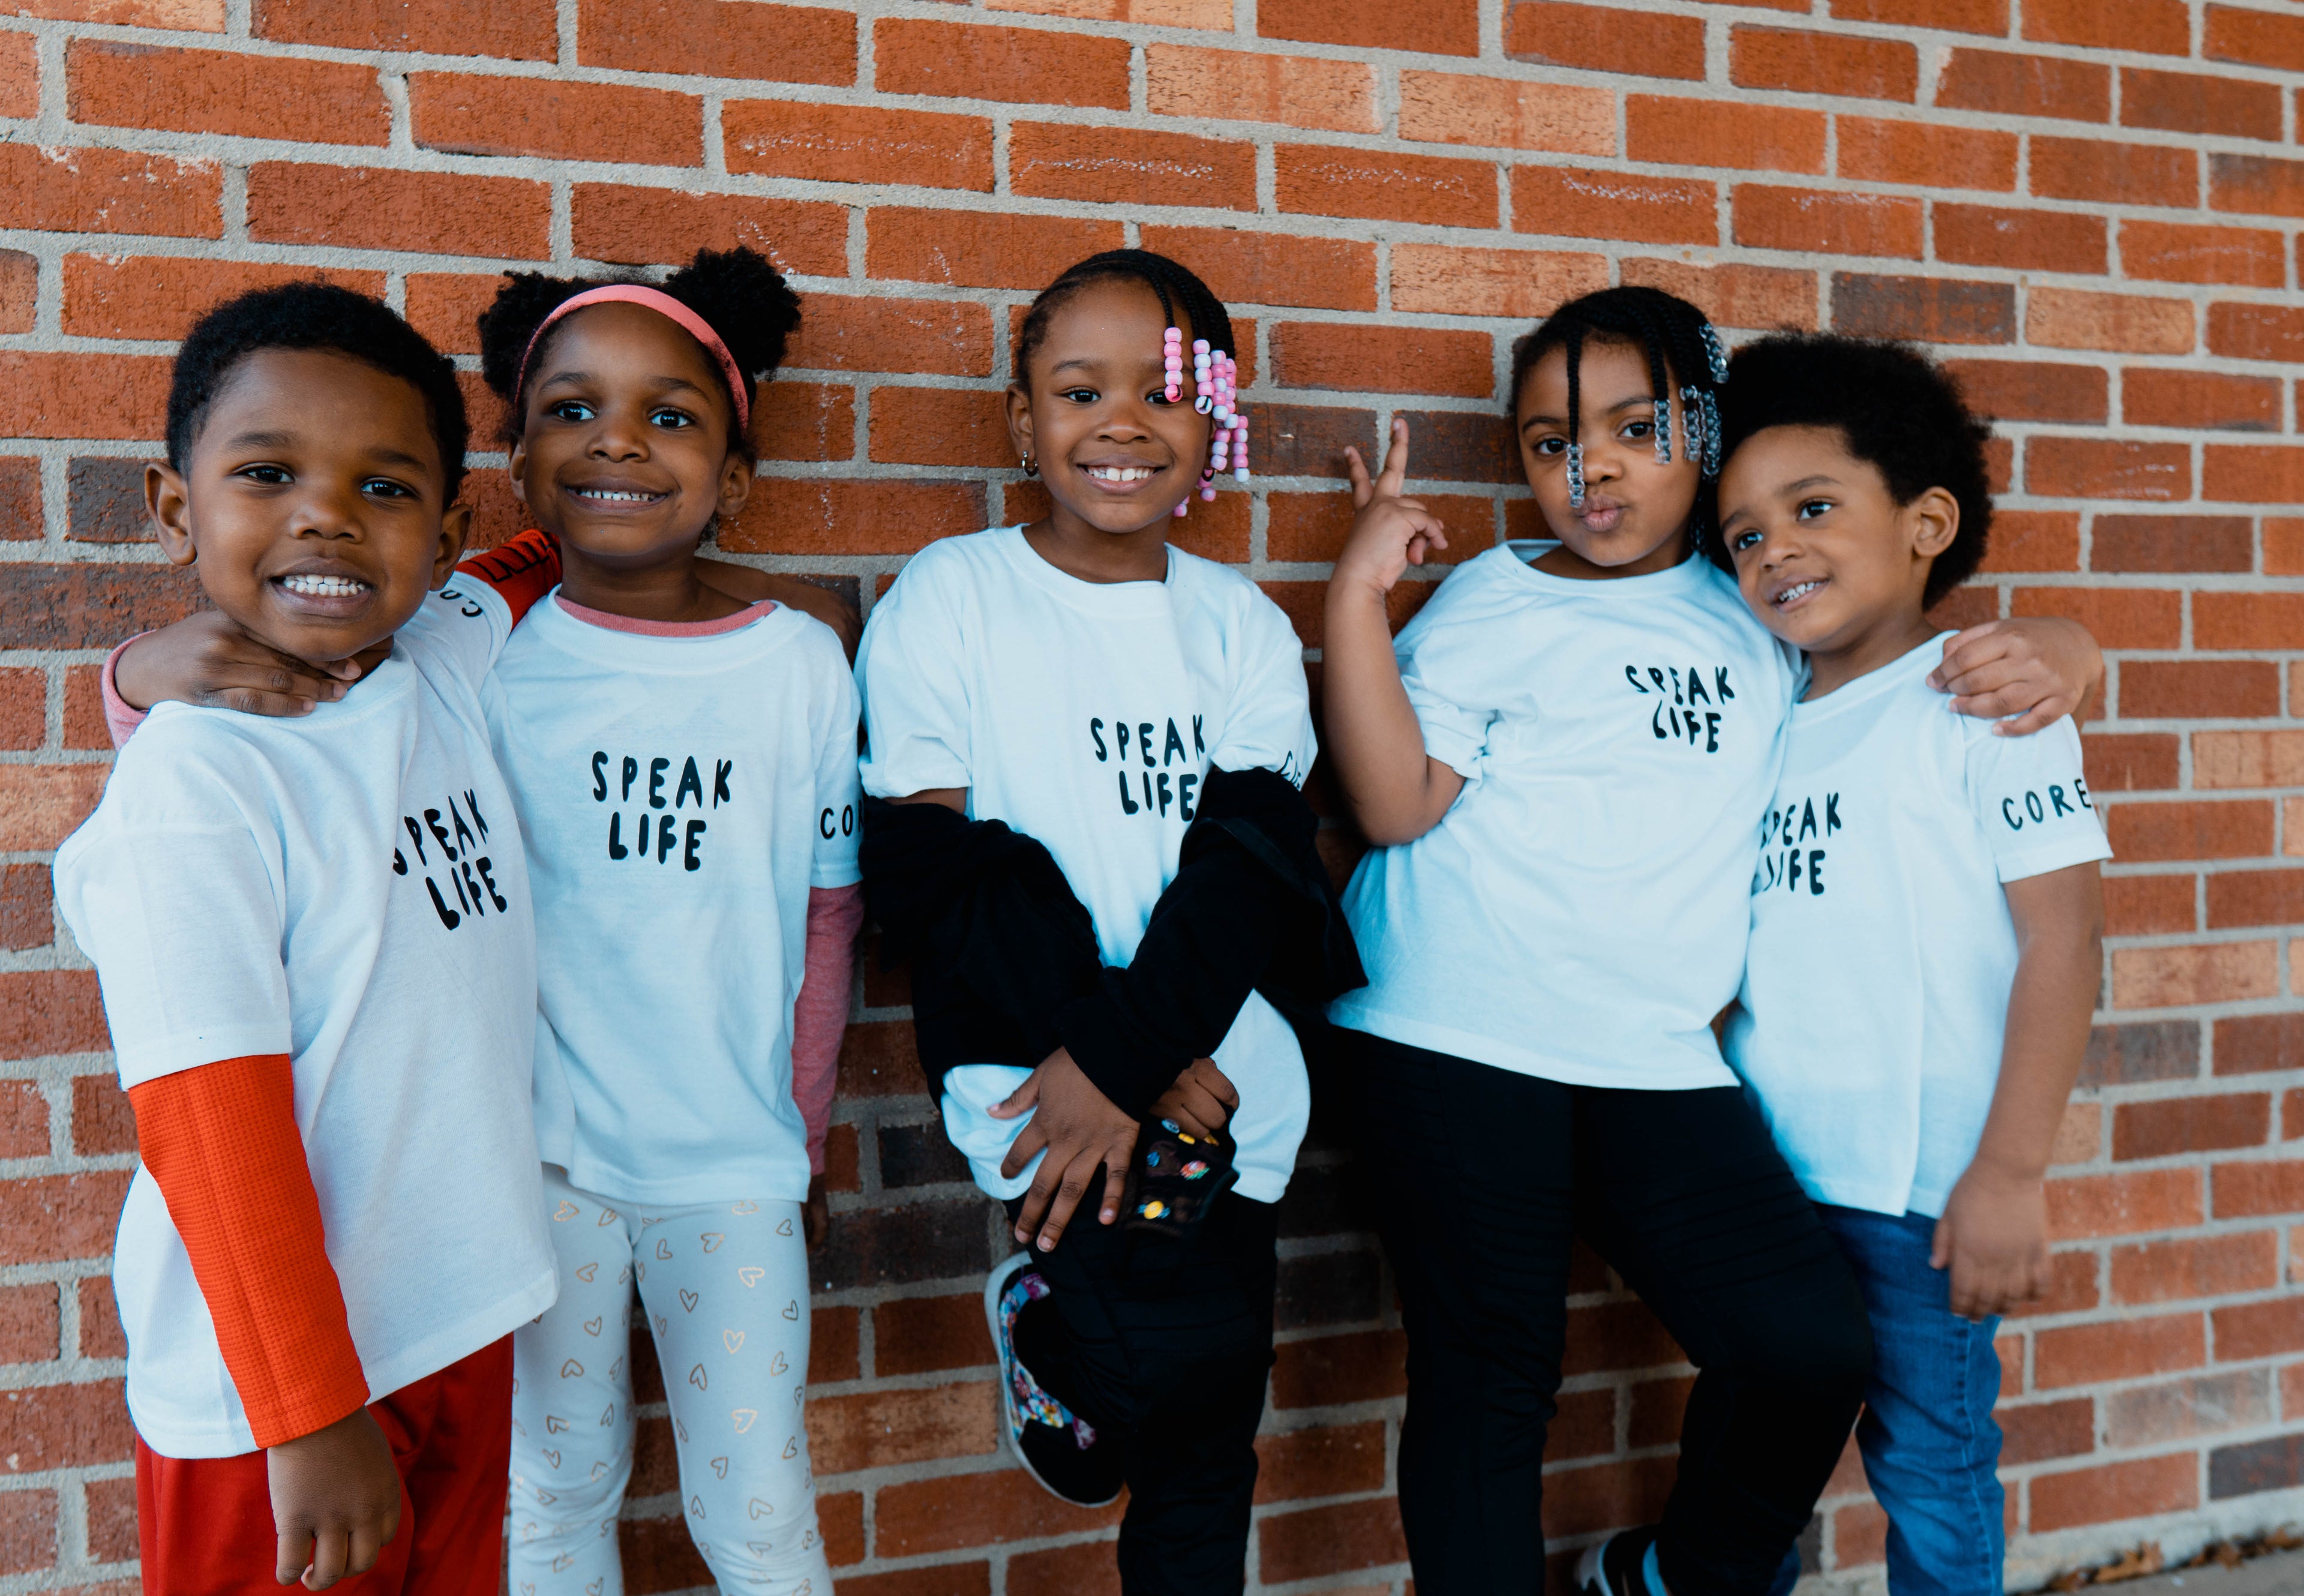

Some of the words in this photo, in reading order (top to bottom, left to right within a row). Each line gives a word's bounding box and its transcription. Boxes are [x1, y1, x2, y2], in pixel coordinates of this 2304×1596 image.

[1625, 665, 1735, 706] SPEAK
[1090, 714, 1205, 768] SPEAK
[1652, 700, 1721, 752] LIFE
[591, 751, 733, 810] SPEAK
[1119, 770, 1198, 822] LIFE
[2002, 778, 2092, 830] CORE
[608, 811, 707, 872] LIFE
[425, 856, 508, 931] LIFE
